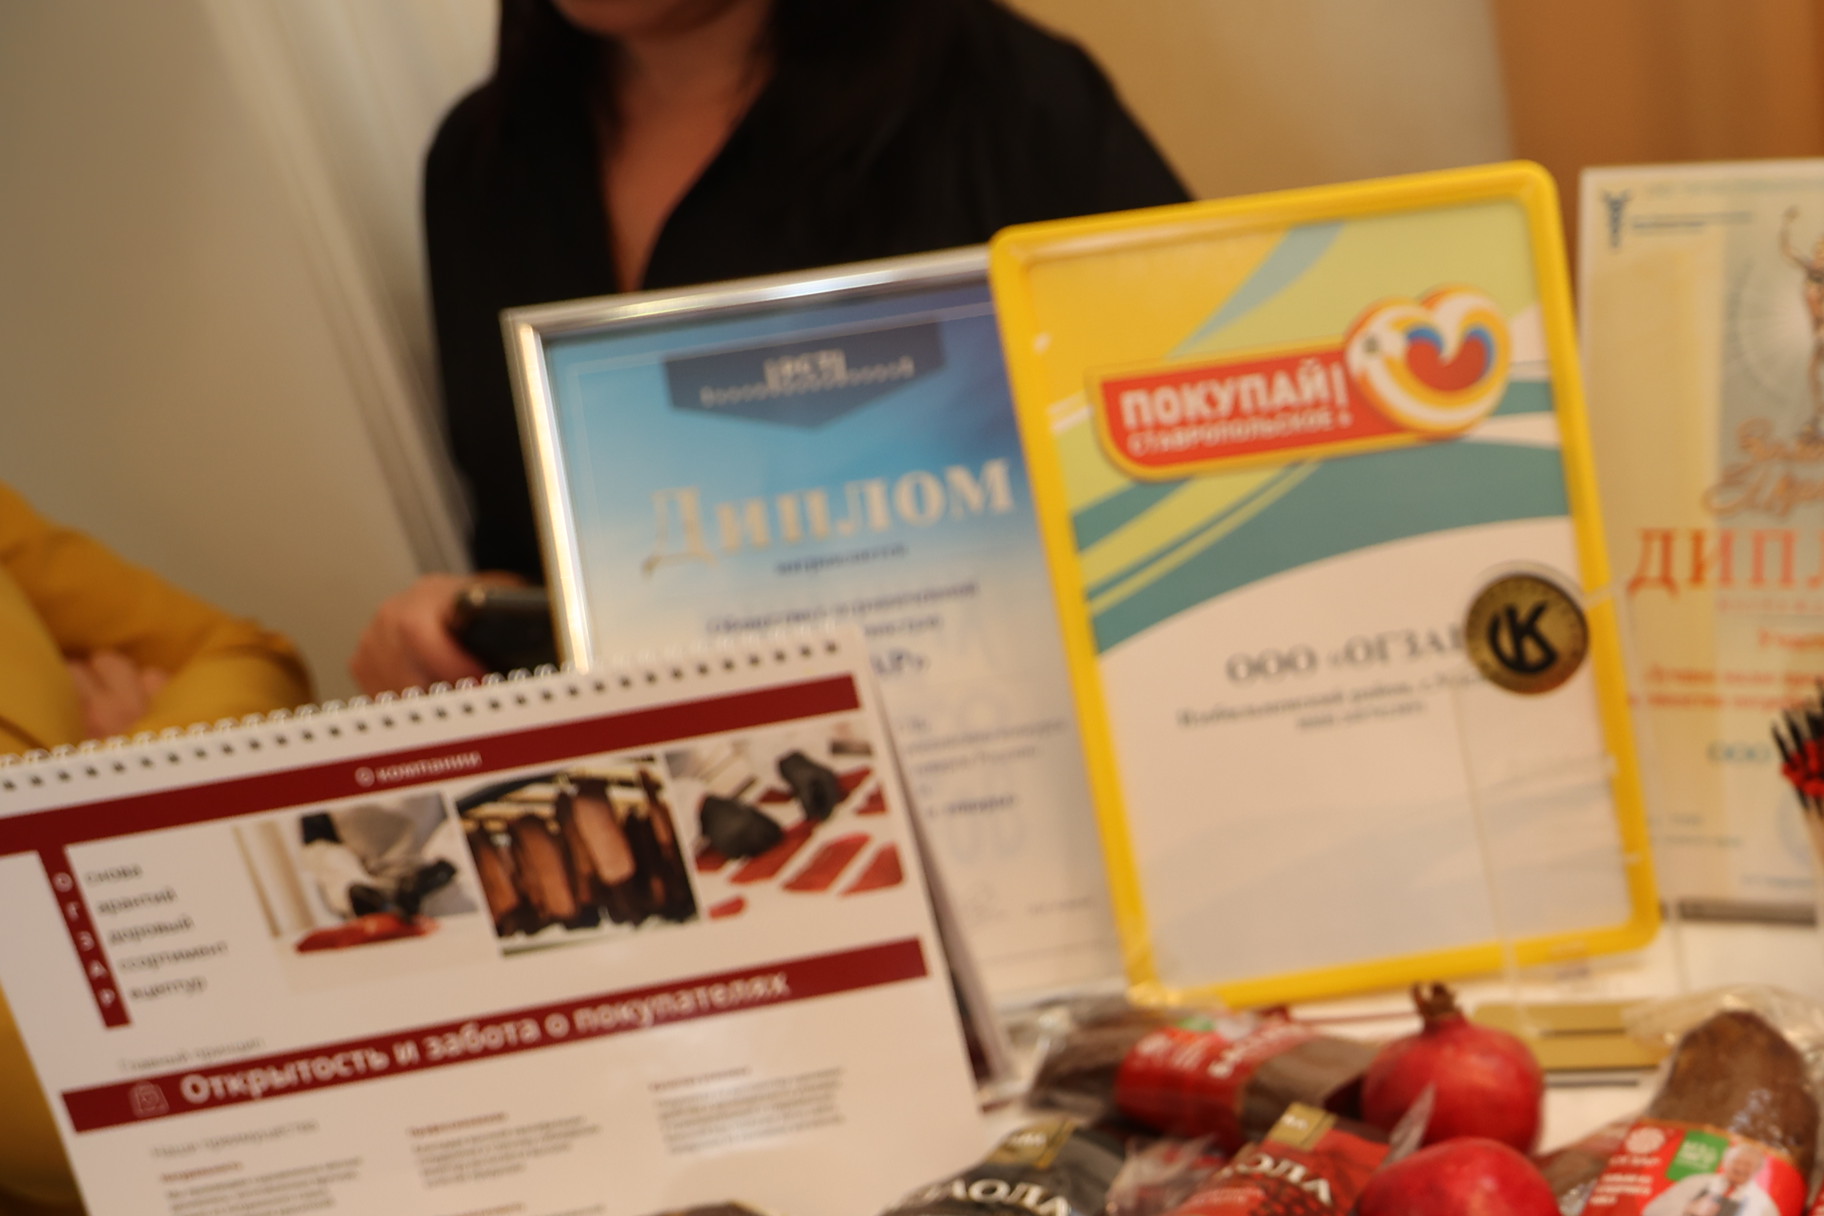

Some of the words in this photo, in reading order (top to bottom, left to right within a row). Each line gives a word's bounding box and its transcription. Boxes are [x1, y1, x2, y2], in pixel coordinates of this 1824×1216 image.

[642, 455, 1015, 578] Диплом
[1224, 643, 1319, 684] ООО
[180, 1041, 389, 1103] Открытость
[394, 1038, 420, 1066] и
[426, 1012, 542, 1062] забота
[545, 1011, 569, 1038] о
[573, 970, 792, 1035] покупателях
